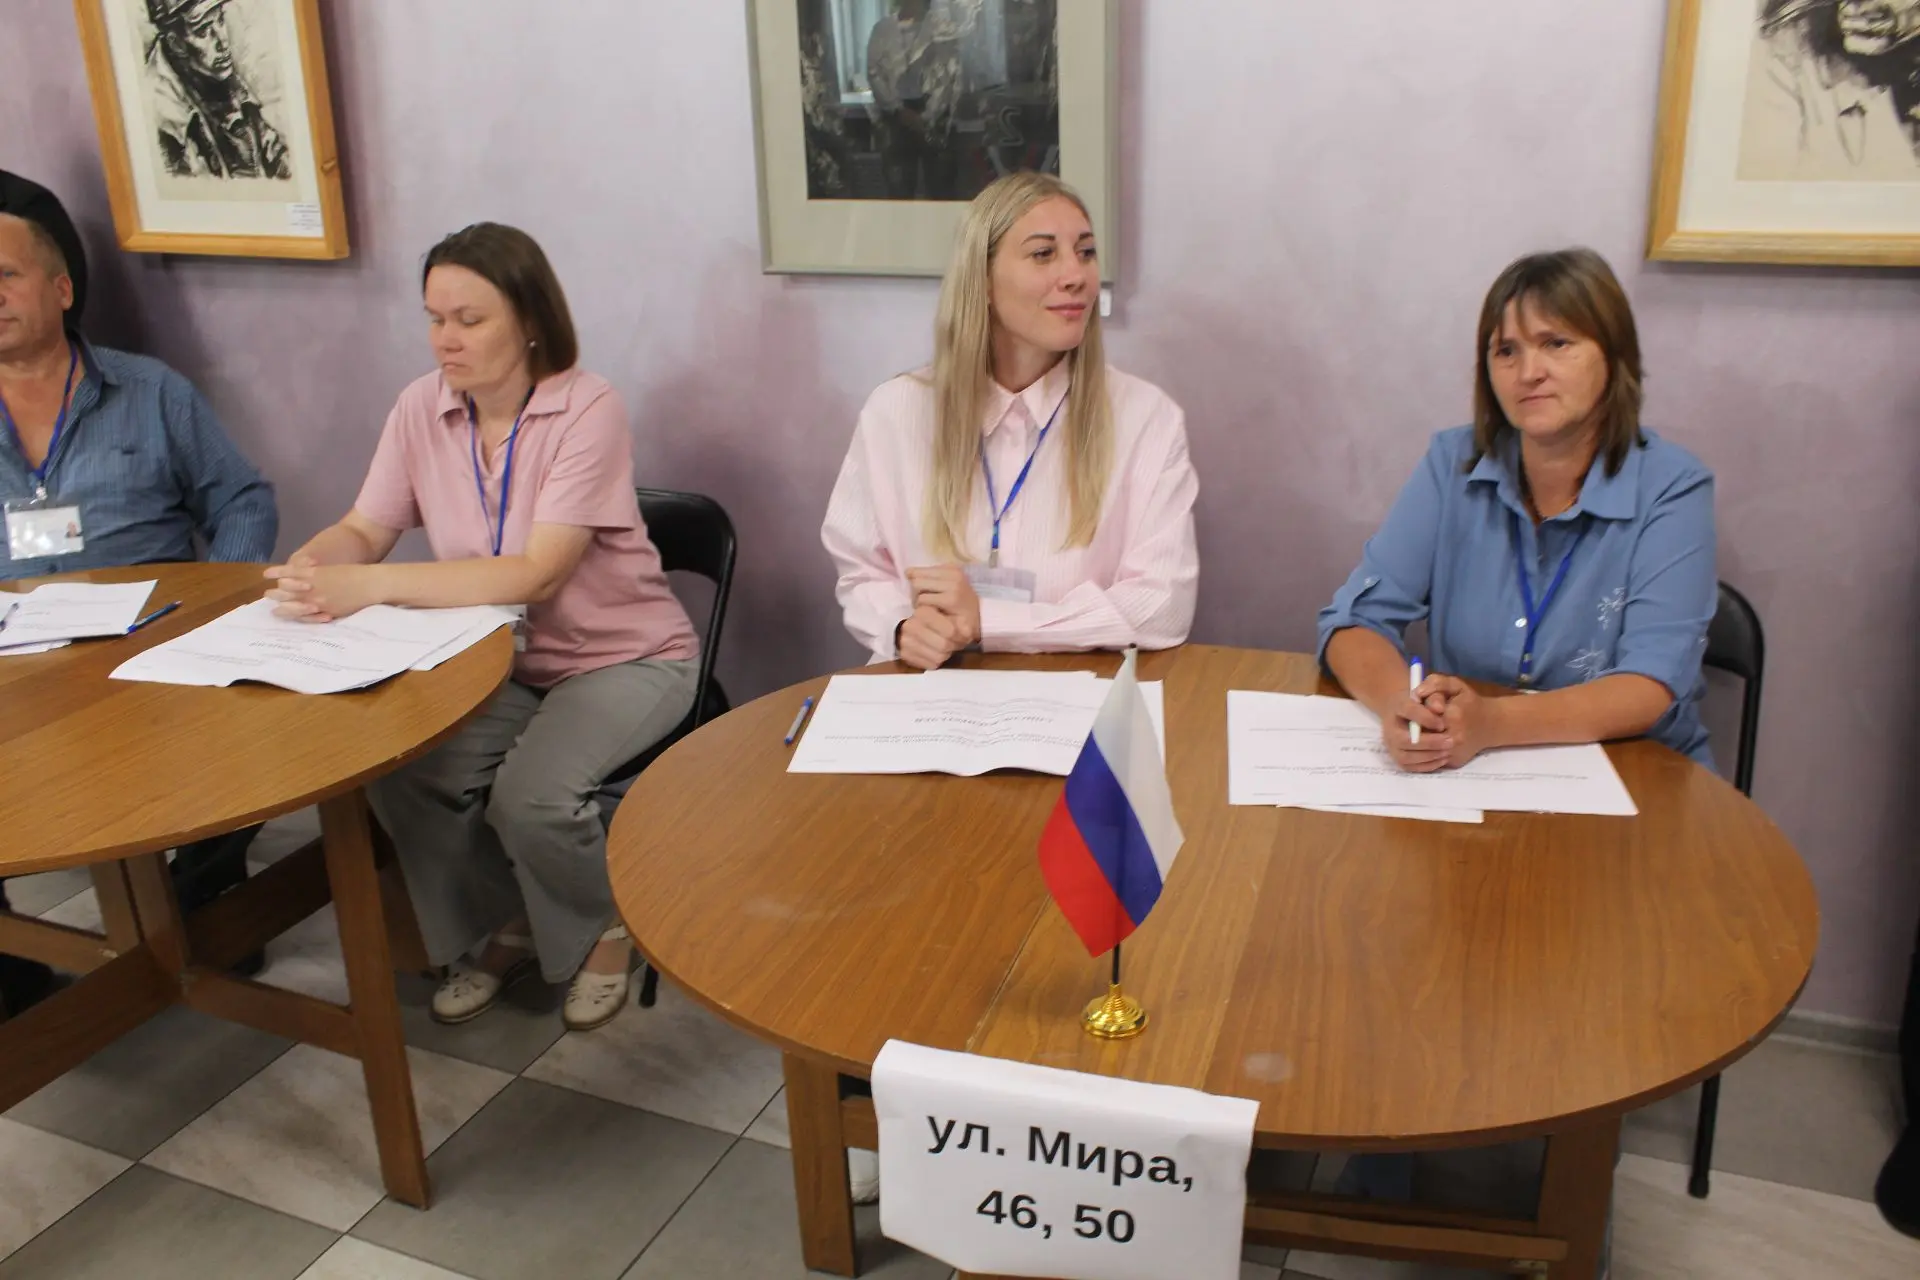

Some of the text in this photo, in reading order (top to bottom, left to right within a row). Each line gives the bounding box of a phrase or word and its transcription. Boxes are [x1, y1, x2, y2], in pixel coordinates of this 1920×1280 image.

[927, 1115, 1193, 1193] ул. Мира,
[976, 1190, 1135, 1244] 46, 50
